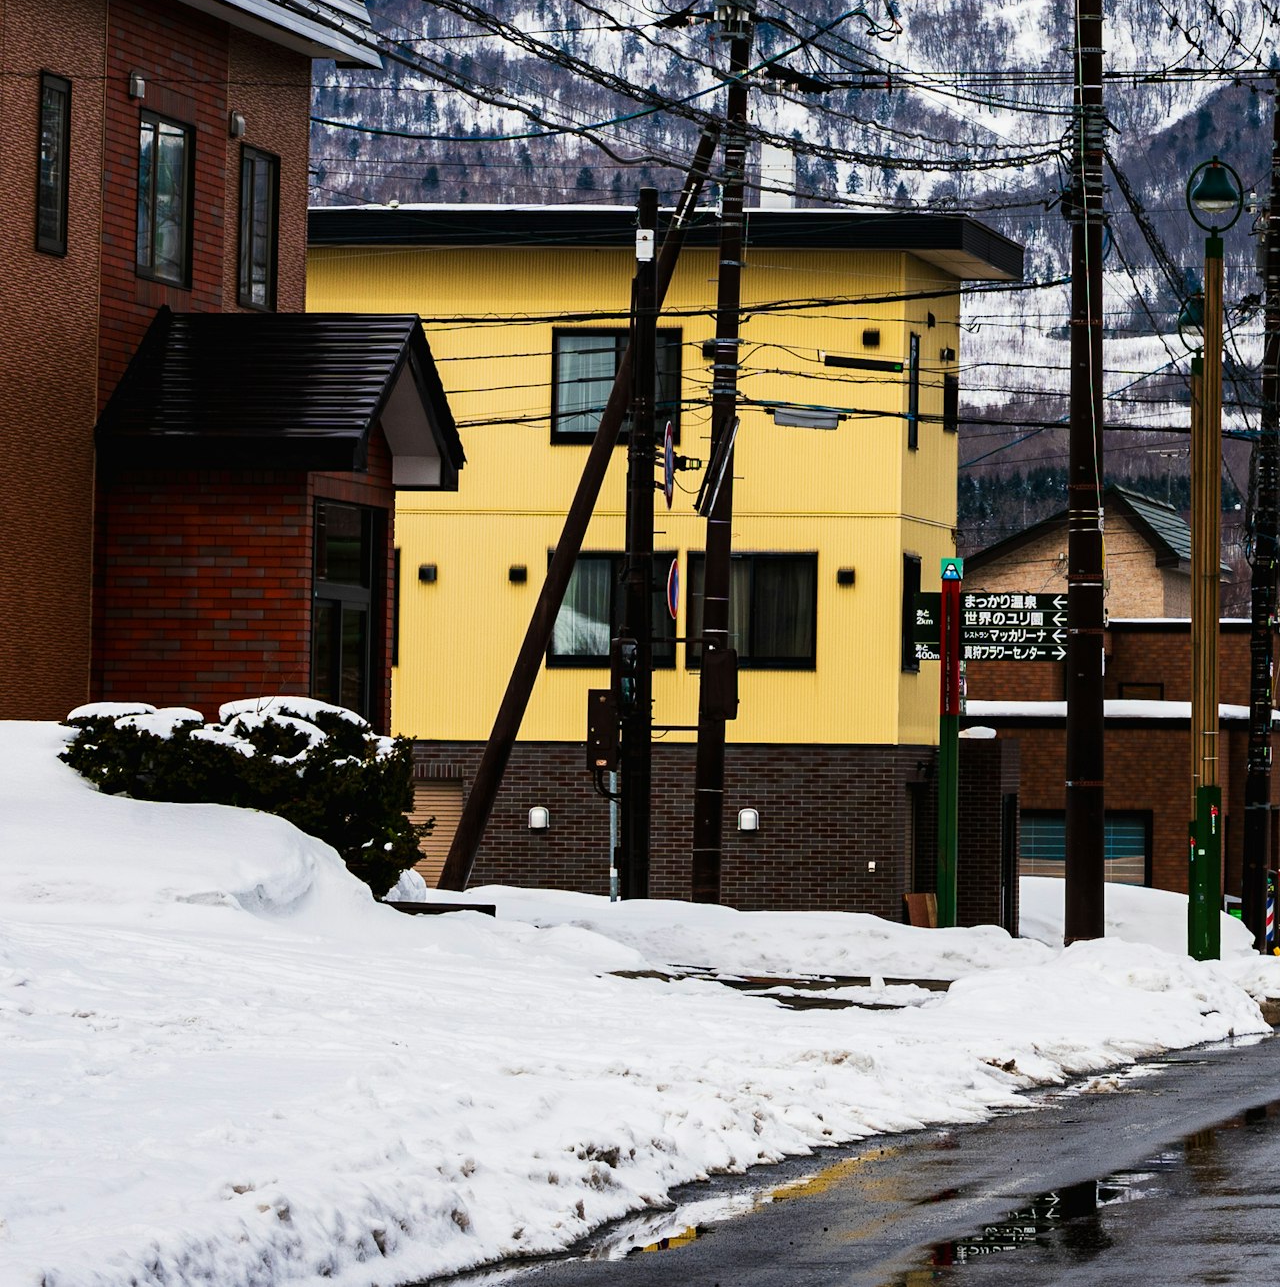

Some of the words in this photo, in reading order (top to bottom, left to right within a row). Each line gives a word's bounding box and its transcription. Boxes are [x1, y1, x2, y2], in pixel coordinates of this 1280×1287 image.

[965, 594, 1037, 609] まっかり温泉
[916, 609, 929, 617] あと
[916, 617, 933, 625] 2km
[964, 611, 1043, 626] 世界のユリ園
[915, 651, 940, 659] 400m
